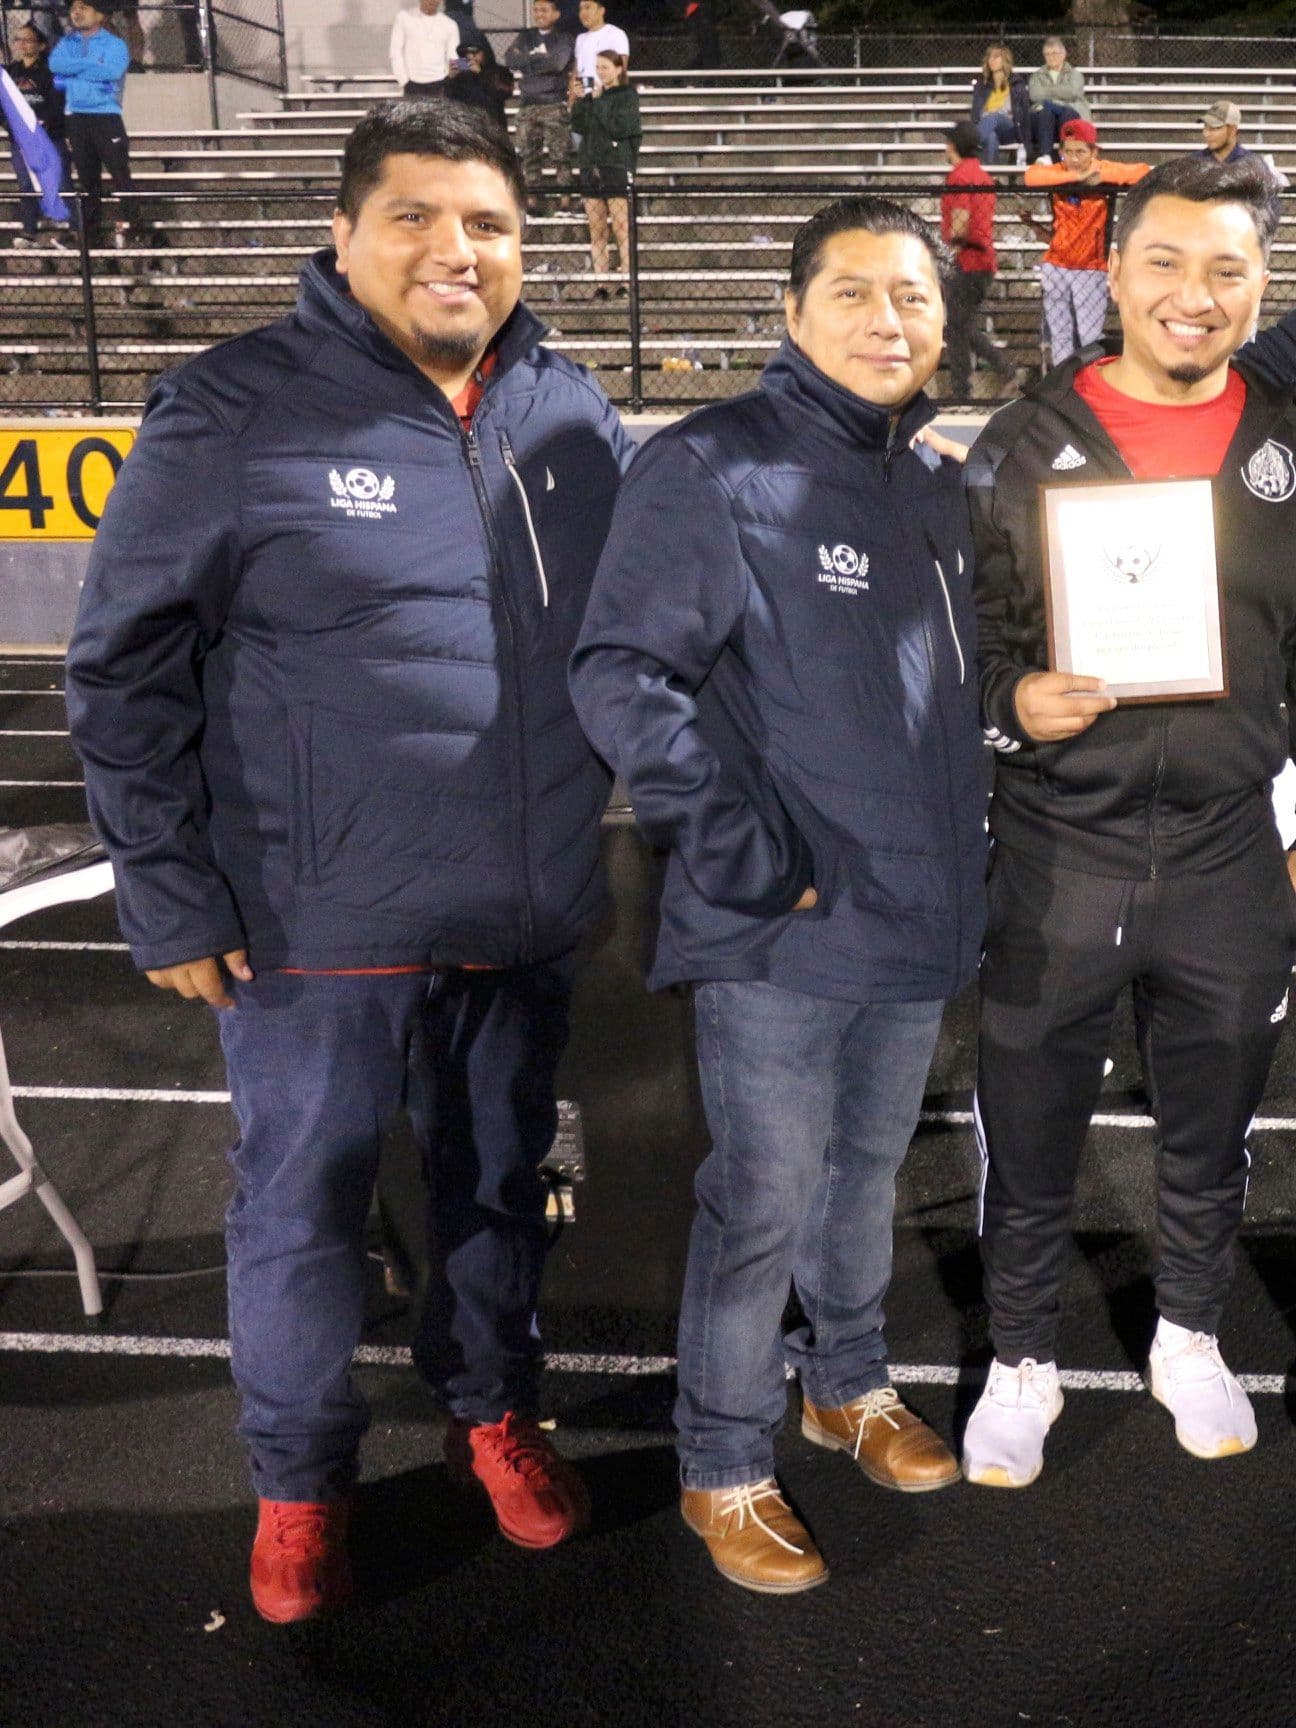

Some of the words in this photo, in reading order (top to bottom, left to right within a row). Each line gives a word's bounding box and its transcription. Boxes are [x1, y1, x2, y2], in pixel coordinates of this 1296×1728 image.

[1052, 456, 1087, 470] adidas
[0, 436, 124, 530] 40
[330, 497, 354, 509] LIGA
[354, 500, 398, 513] HISPANA
[818, 573, 837, 584] LIGA
[838, 576, 870, 590] HISPANA
